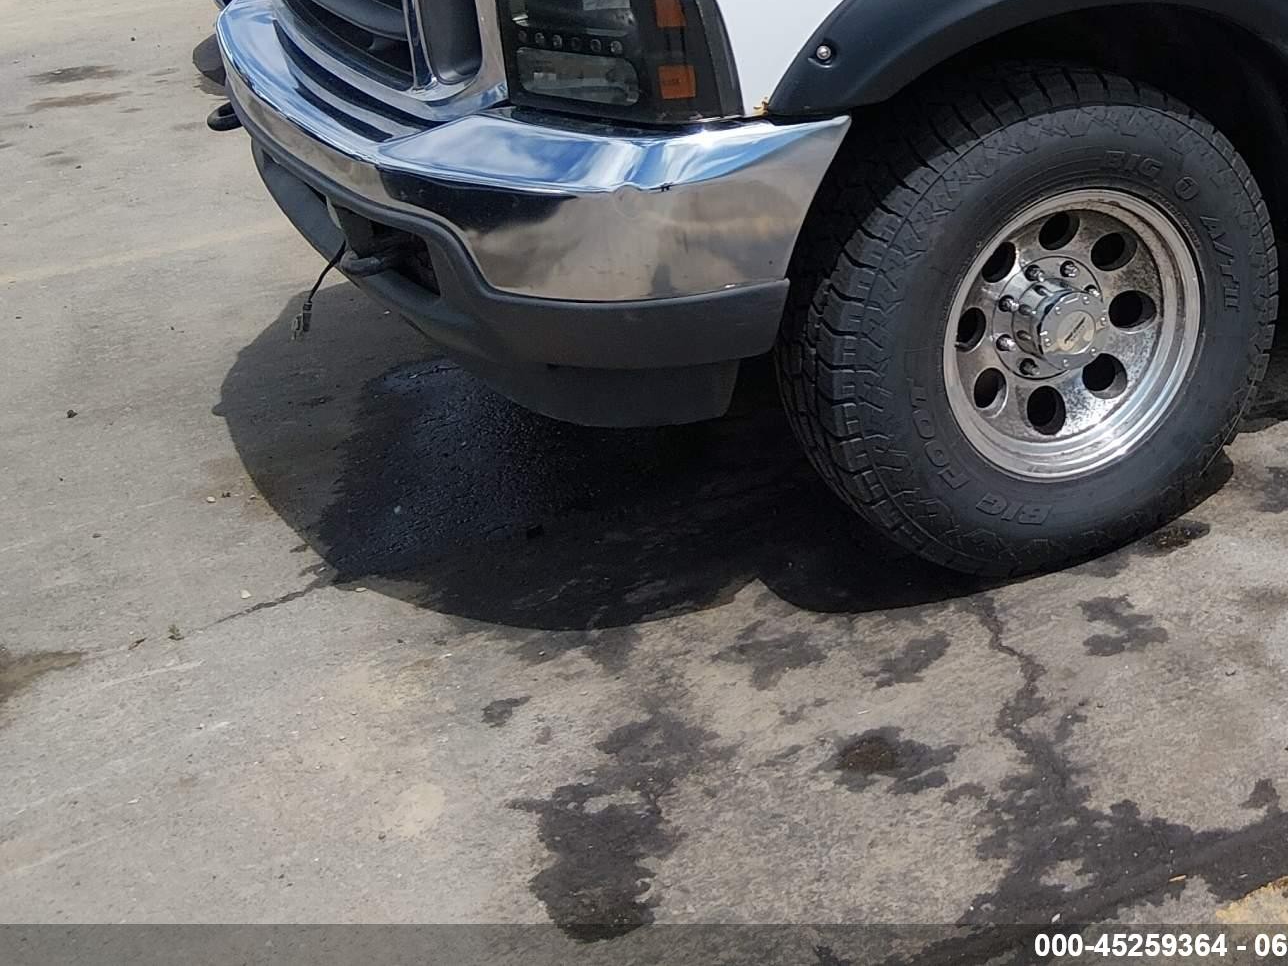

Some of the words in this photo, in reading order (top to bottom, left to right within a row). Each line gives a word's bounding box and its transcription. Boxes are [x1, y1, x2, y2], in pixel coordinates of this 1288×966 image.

[1105, 150, 1163, 178] BIG
[906, 377, 971, 490] FOOT
[976, 492, 1053, 525] BIG
